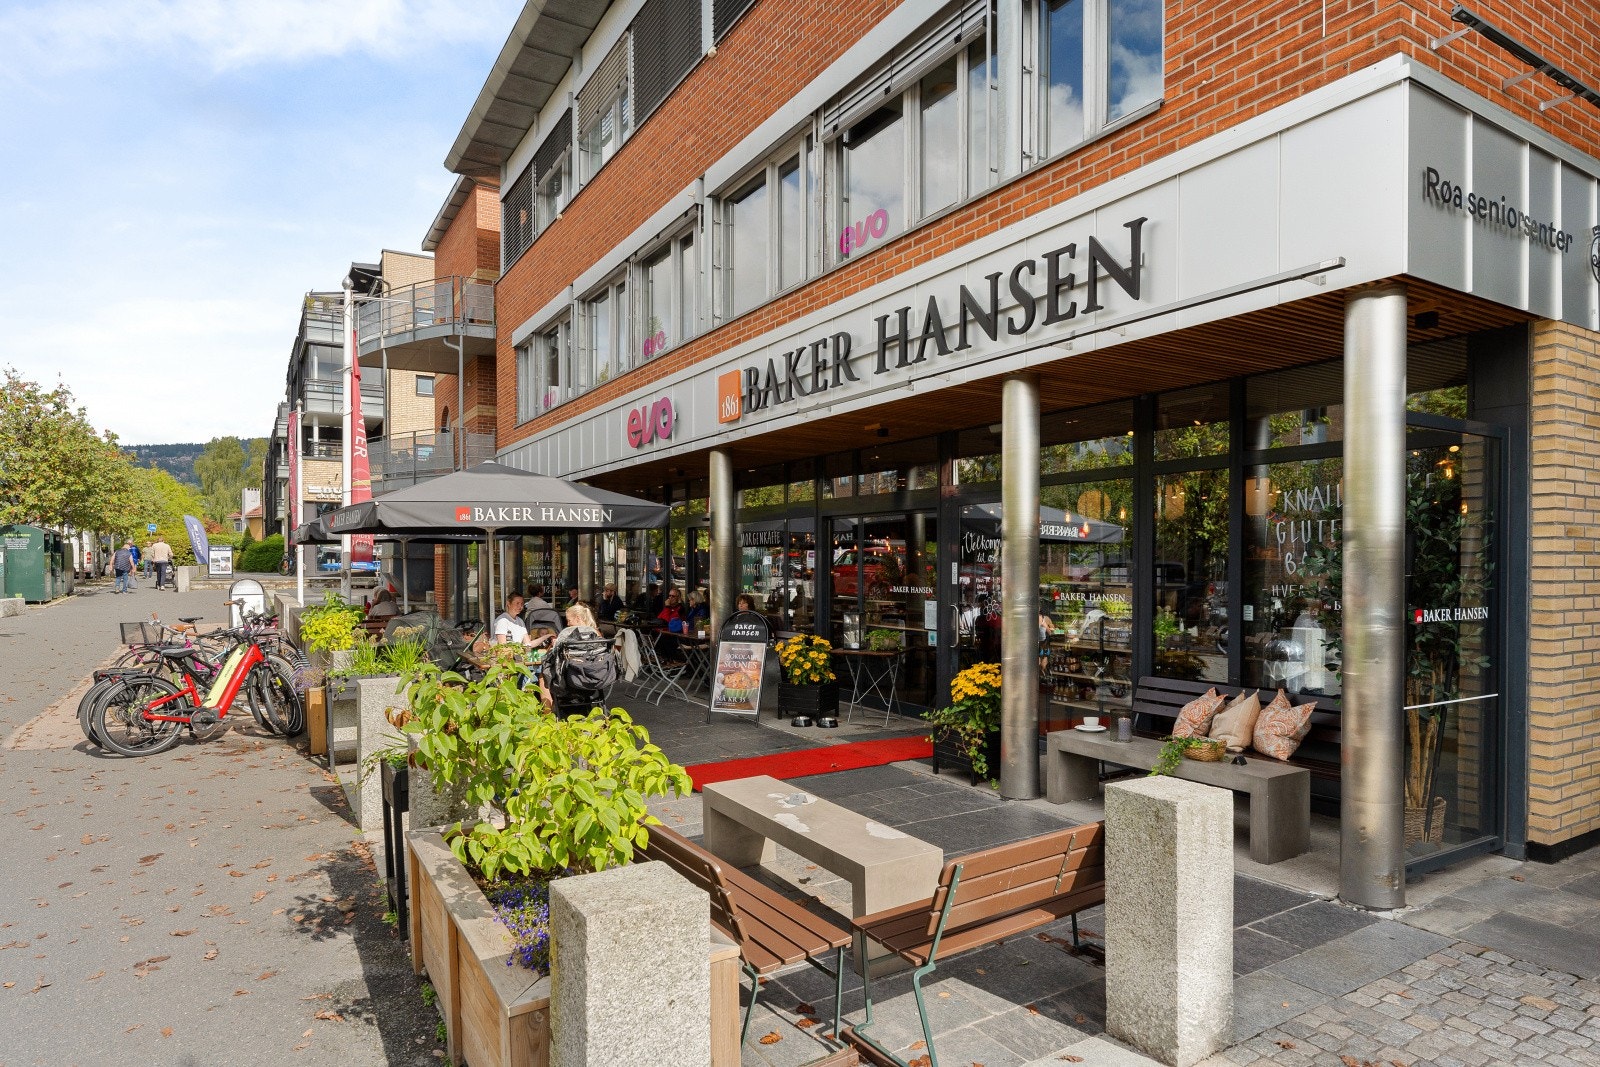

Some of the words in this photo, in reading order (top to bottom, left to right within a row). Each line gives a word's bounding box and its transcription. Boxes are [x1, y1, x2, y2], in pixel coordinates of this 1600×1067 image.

[1426, 166, 1463, 210] Røa
[1467, 192, 1573, 253] seniorsenter
[839, 208, 889, 255] evo
[721, 397, 740, 418] 1861
[743, 331, 861, 415] BAKER
[874, 216, 1149, 376] HANSEN
[627, 396, 673, 449] evo
[474, 507, 535, 522] BAKER
[541, 507, 613, 523] HANSEN
[893, 585, 910, 593] BAKER
[911, 586, 934, 594] HANSEN
[1060, 592, 1087, 602] BAKER
[1089, 592, 1125, 603] HANSEN
[1423, 608, 1452, 623] BAKER
[1454, 606, 1489, 621] HANSEN
